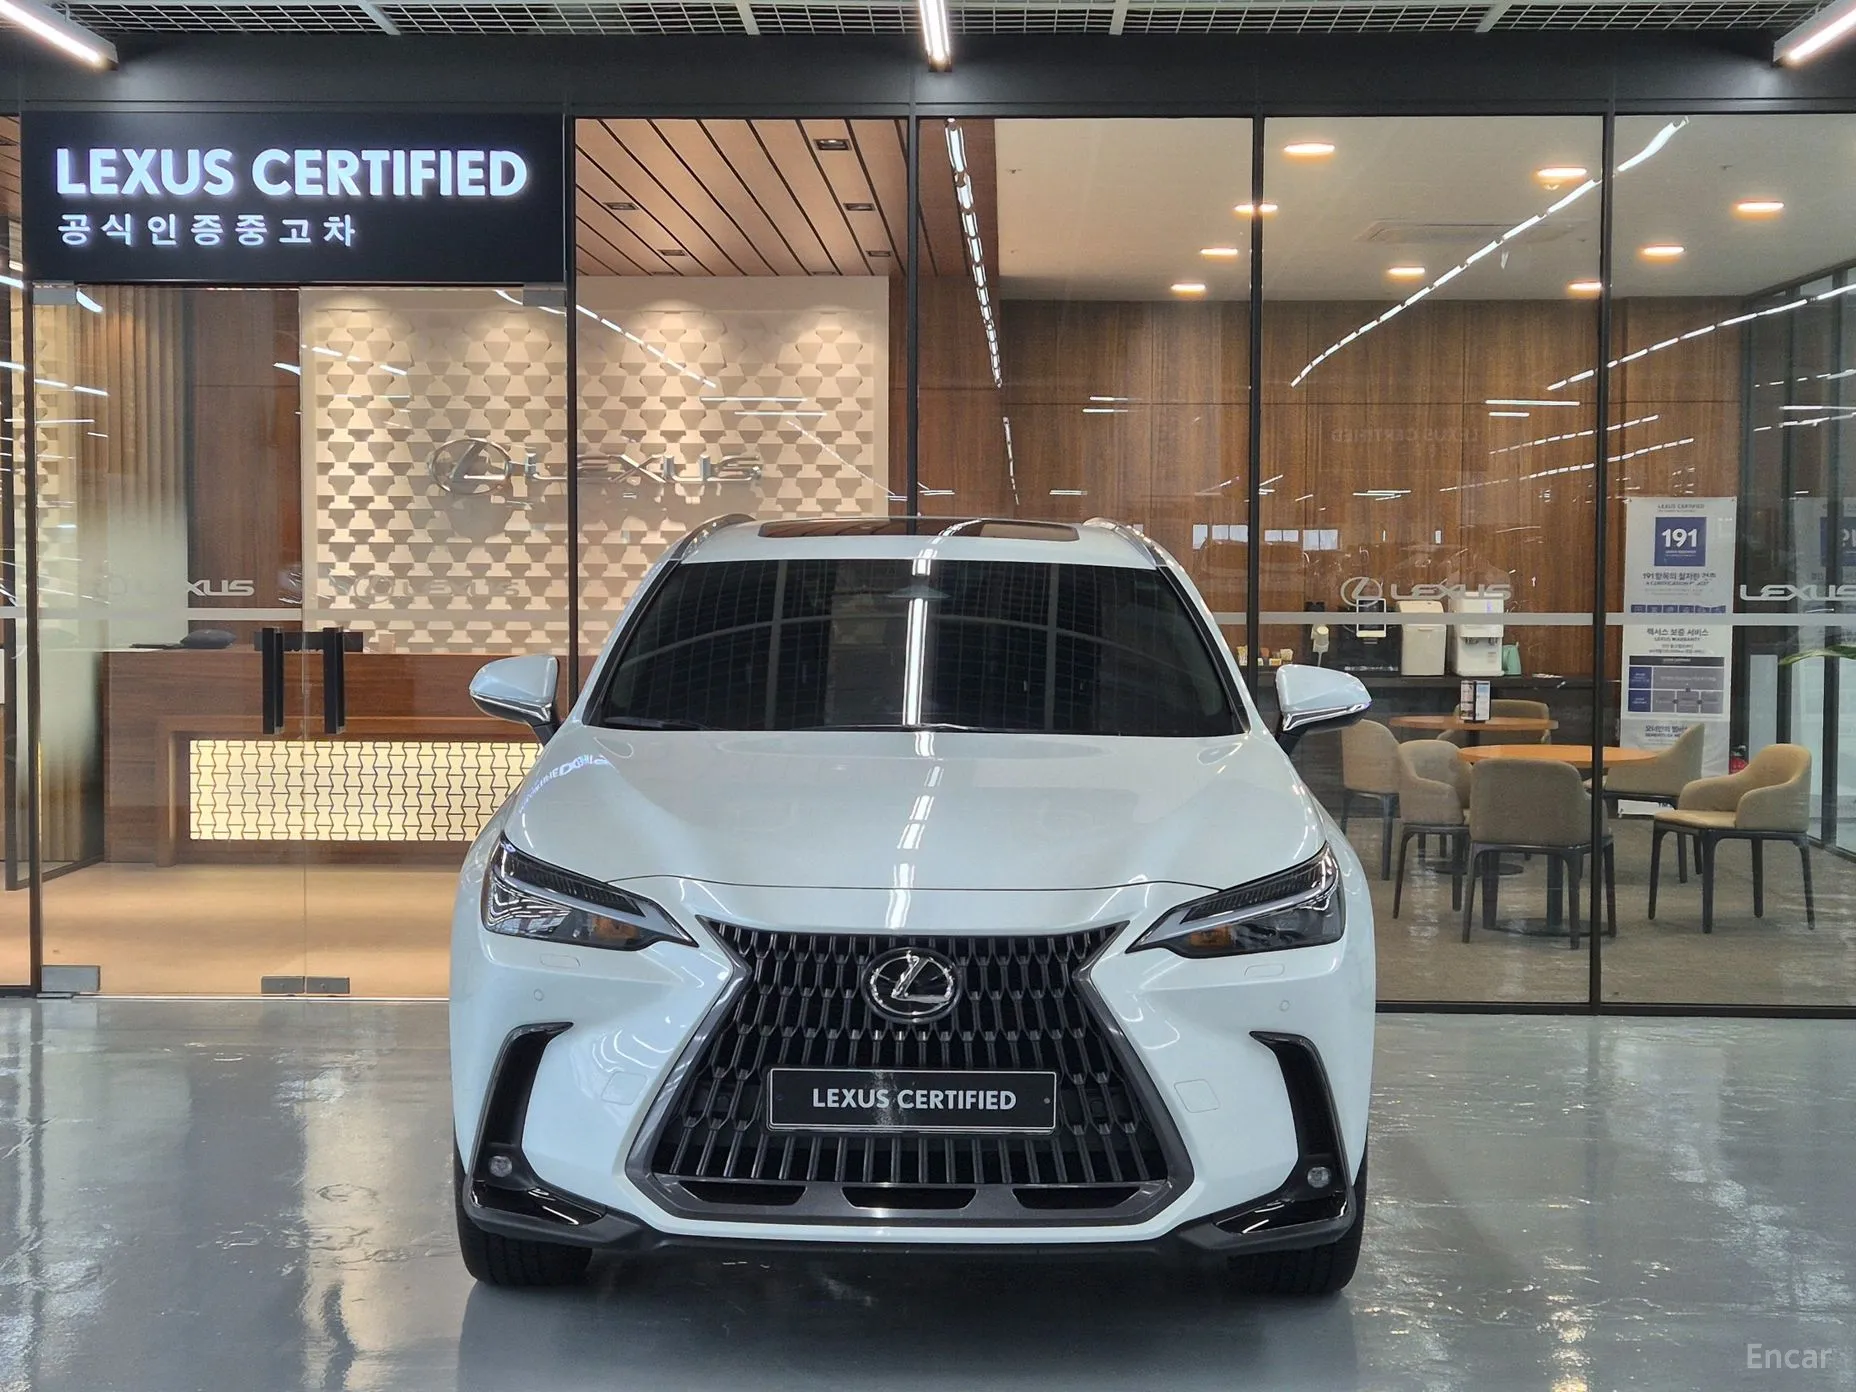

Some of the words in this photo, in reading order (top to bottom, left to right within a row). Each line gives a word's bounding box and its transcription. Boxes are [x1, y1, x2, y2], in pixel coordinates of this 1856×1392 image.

[56, 147, 234, 196] LEXUS
[252, 148, 528, 197] CERTIFIED
[524, 452, 763, 484] LEXUS
[1662, 528, 1698, 548] 191
[186, 578, 255, 599] XUS
[1390, 583, 1512, 601] LEXUS
[1739, 584, 1856, 602] LEXUS
[812, 1088, 890, 1109] LEXUS
[896, 1089, 1017, 1110] CERTIFIED
